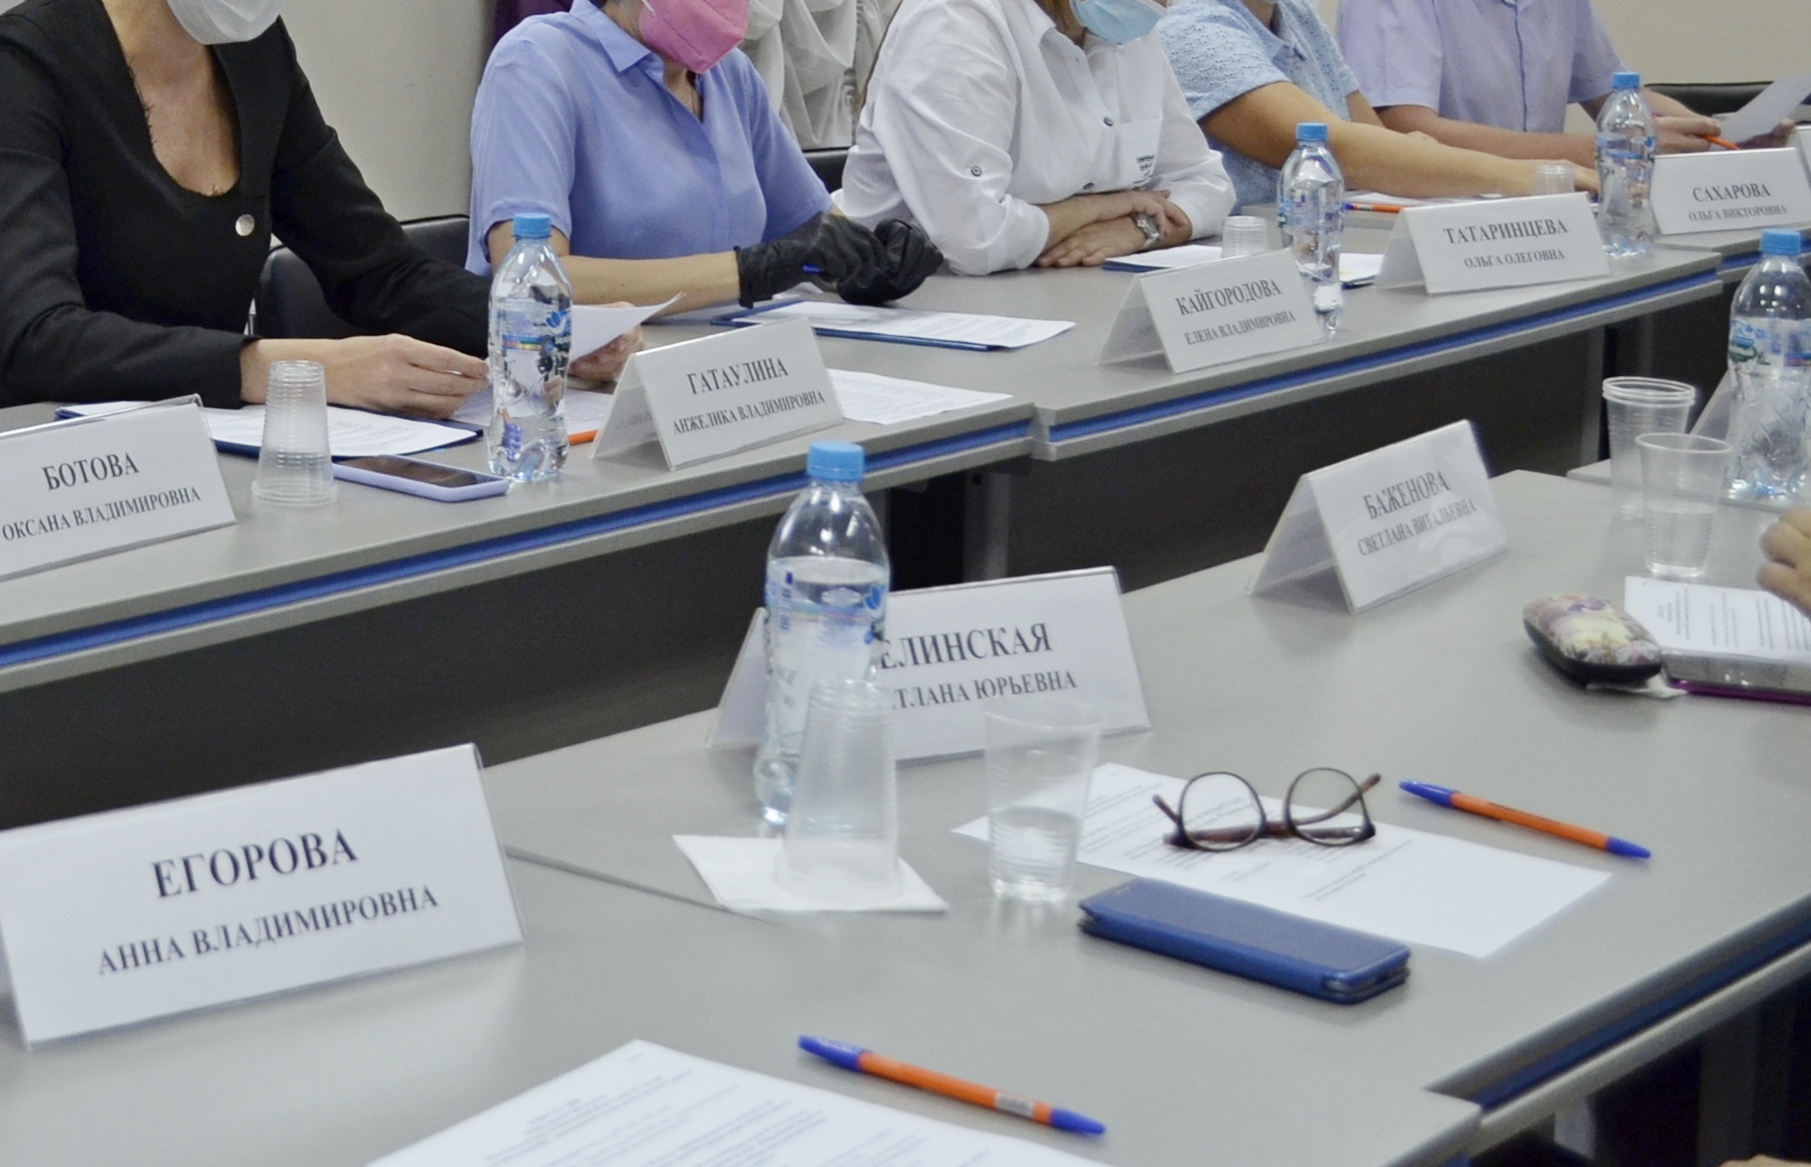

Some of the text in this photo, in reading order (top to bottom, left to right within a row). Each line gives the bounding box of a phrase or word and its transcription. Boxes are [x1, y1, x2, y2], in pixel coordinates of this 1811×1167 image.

[1692, 183, 1771, 202] САХАРОВА
[1443, 219, 1568, 244] ТАТАРИНЦЕВА
[1464, 249, 1565, 268] ОЛЬГА ОЛЕГОВНА
[1175, 279, 1282, 315] КАЙГОРОДОВА
[1184, 310, 1296, 345] ЕЛЕНА ВЛАДИМИРОВНА
[687, 357, 788, 395] ГАТАУЛИНА
[673, 408, 738, 434] АНЖЕЛИКА
[737, 390, 826, 420] ВЛАДИМИРОВНА
[42, 452, 140, 491] БОТОВА
[2, 514, 72, 541] ОКСАНА
[72, 486, 202, 527] ВЛАДИМИРОВНА
[1363, 470, 1451, 519] БАЖЕНОВА
[1357, 498, 1476, 556] СВЕТЛАНА ВИТАЛЬЕВНА
[879, 622, 1052, 670] ЕЛИНСКАЯ
[892, 670, 1077, 709] ТЛАНА ЮРЬЕВНА
[152, 828, 359, 899] ЕГОРОВА
[99, 884, 438, 975] АННА ВЛАДИМИРОВНА
